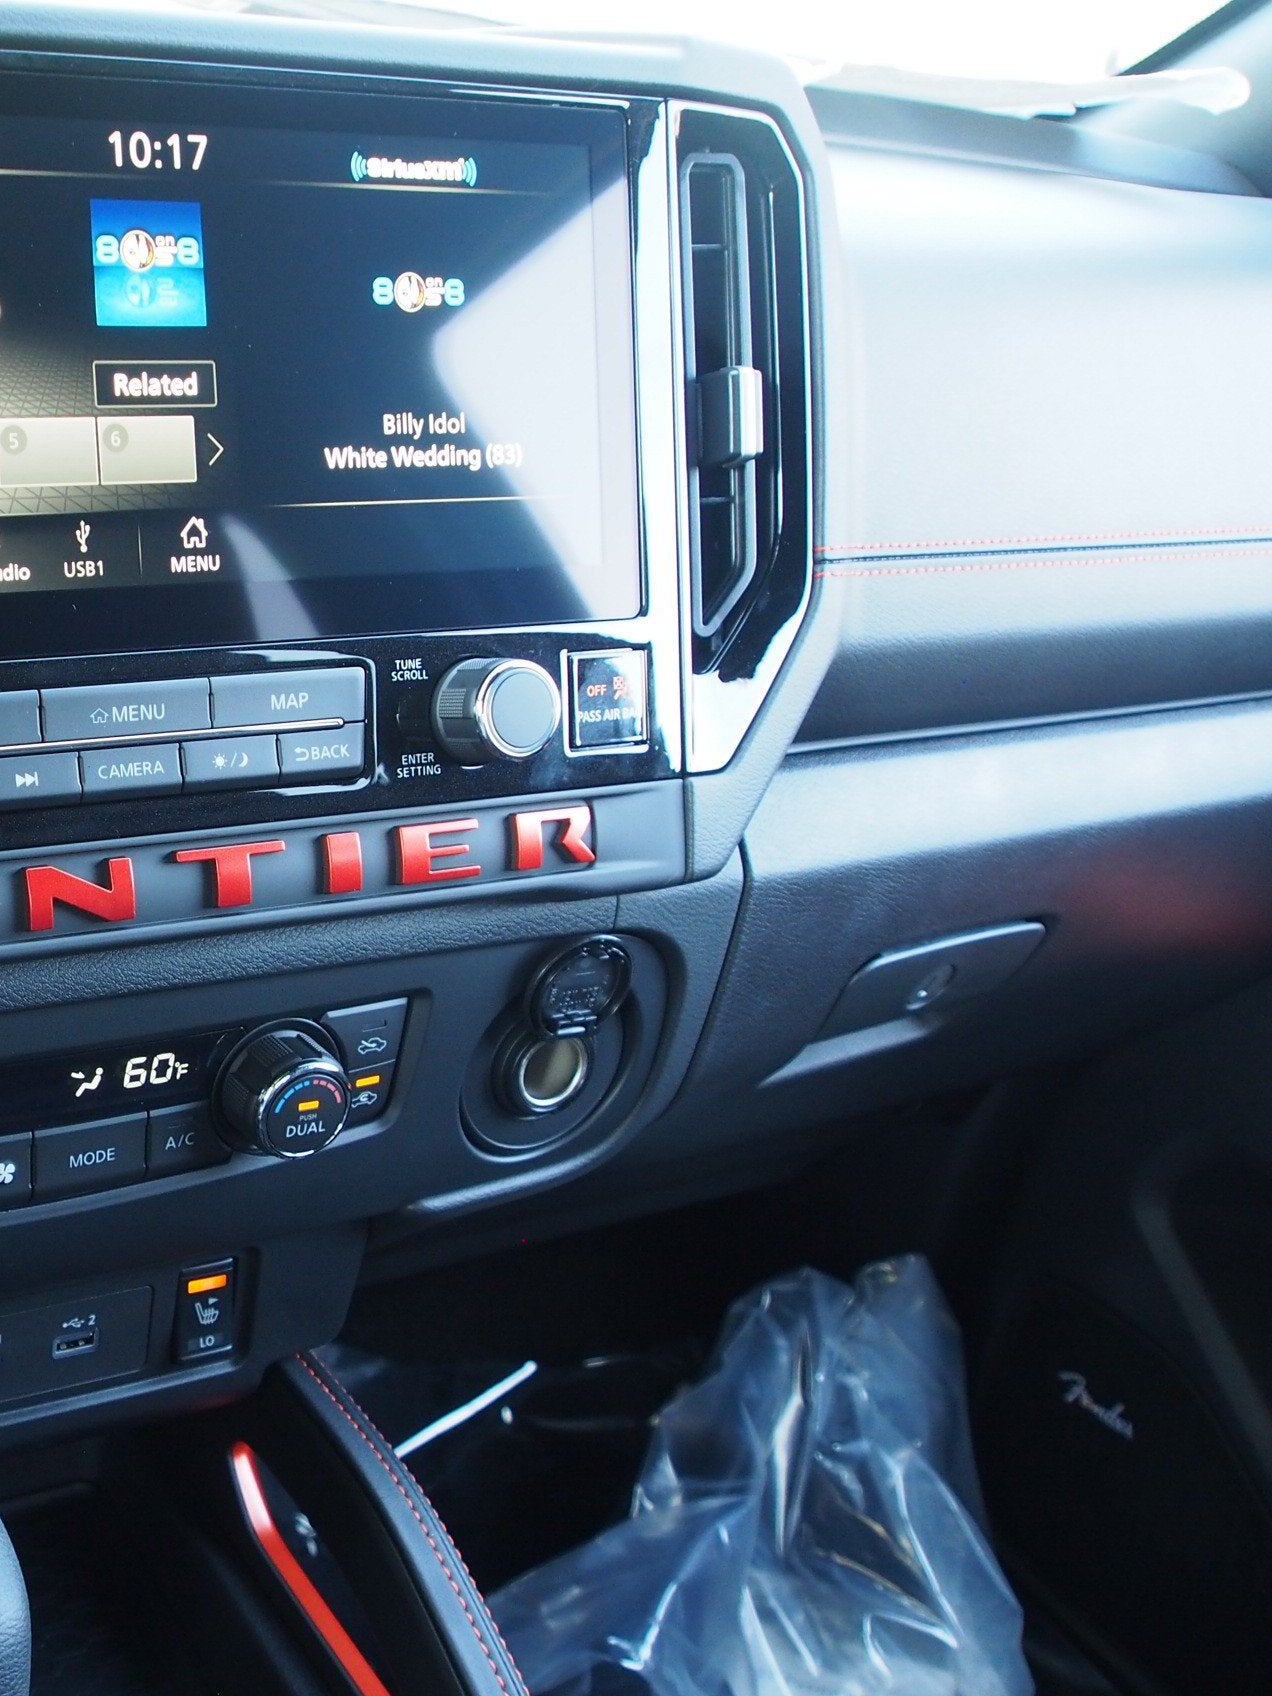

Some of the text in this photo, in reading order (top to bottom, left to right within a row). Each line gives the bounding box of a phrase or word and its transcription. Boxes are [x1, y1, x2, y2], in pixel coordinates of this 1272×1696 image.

[107, 130, 209, 170] 10:17
[113, 371, 199, 399] Related
[382, 411, 466, 440] Billy Idol
[323, 442, 523, 472] White Wedding (83)
[63, 559, 105, 579] USB1
[170, 554, 221, 574] MENU
[394, 658, 422, 671] TUNE
[391, 668, 429, 682] SCROLL
[586, 684, 607, 698] OFF
[270, 691, 309, 711] MAP
[111, 702, 166, 723] MENU
[578, 709, 603, 723] PASS
[603, 707, 621, 720] AIR
[311, 743, 351, 761] BACK
[401, 752, 434, 765] ENTER
[97, 760, 166, 782] CAMERA
[396, 764, 442, 778] SETTING
[299, 1113, 318, 1122] PUSH
[285, 1120, 326, 1139] DUAL
[164, 1131, 195, 1151] A/C
[69, 1146, 116, 1169] MODE
[87, 1314, 97, 1326] 2
[200, 1335, 215, 1348] LO
